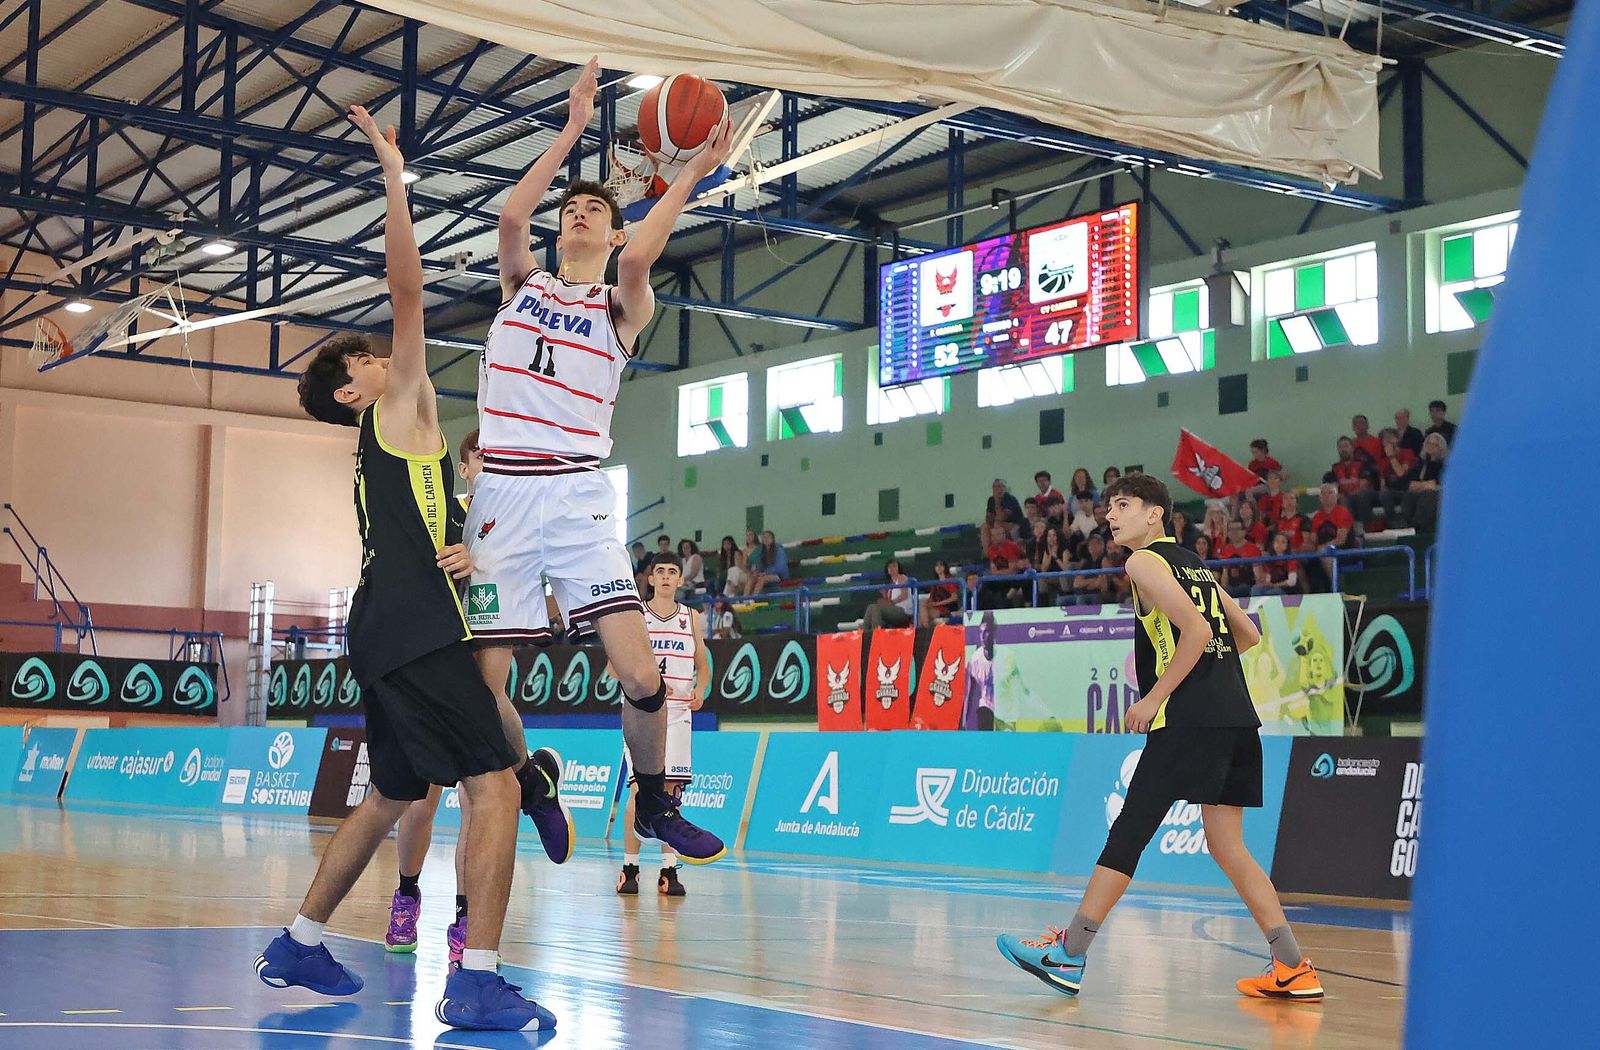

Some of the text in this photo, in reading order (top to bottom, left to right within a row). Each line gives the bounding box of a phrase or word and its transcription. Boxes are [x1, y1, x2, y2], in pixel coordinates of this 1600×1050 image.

[980, 267, 1022, 296] 9:19
[516, 294, 593, 338] PULEVA
[1044, 319, 1073, 346] 47
[527, 336, 556, 378] 11
[934, 343, 959, 368] 52
[422, 464, 436, 500] CARMEN
[427, 502, 437, 518] DEL
[1191, 585, 1229, 634] 24
[651, 640, 685, 651] ULEVA
[120, 749, 164, 780] cajasur
[564, 759, 611, 782] línea
[254, 770, 300, 788] BASKET
[689, 772, 733, 790] oncesto
[961, 768, 1060, 798] Diputación
[775, 819, 860, 838] Junta de Andalucía
[955, 803, 1036, 832] de Cádiz
